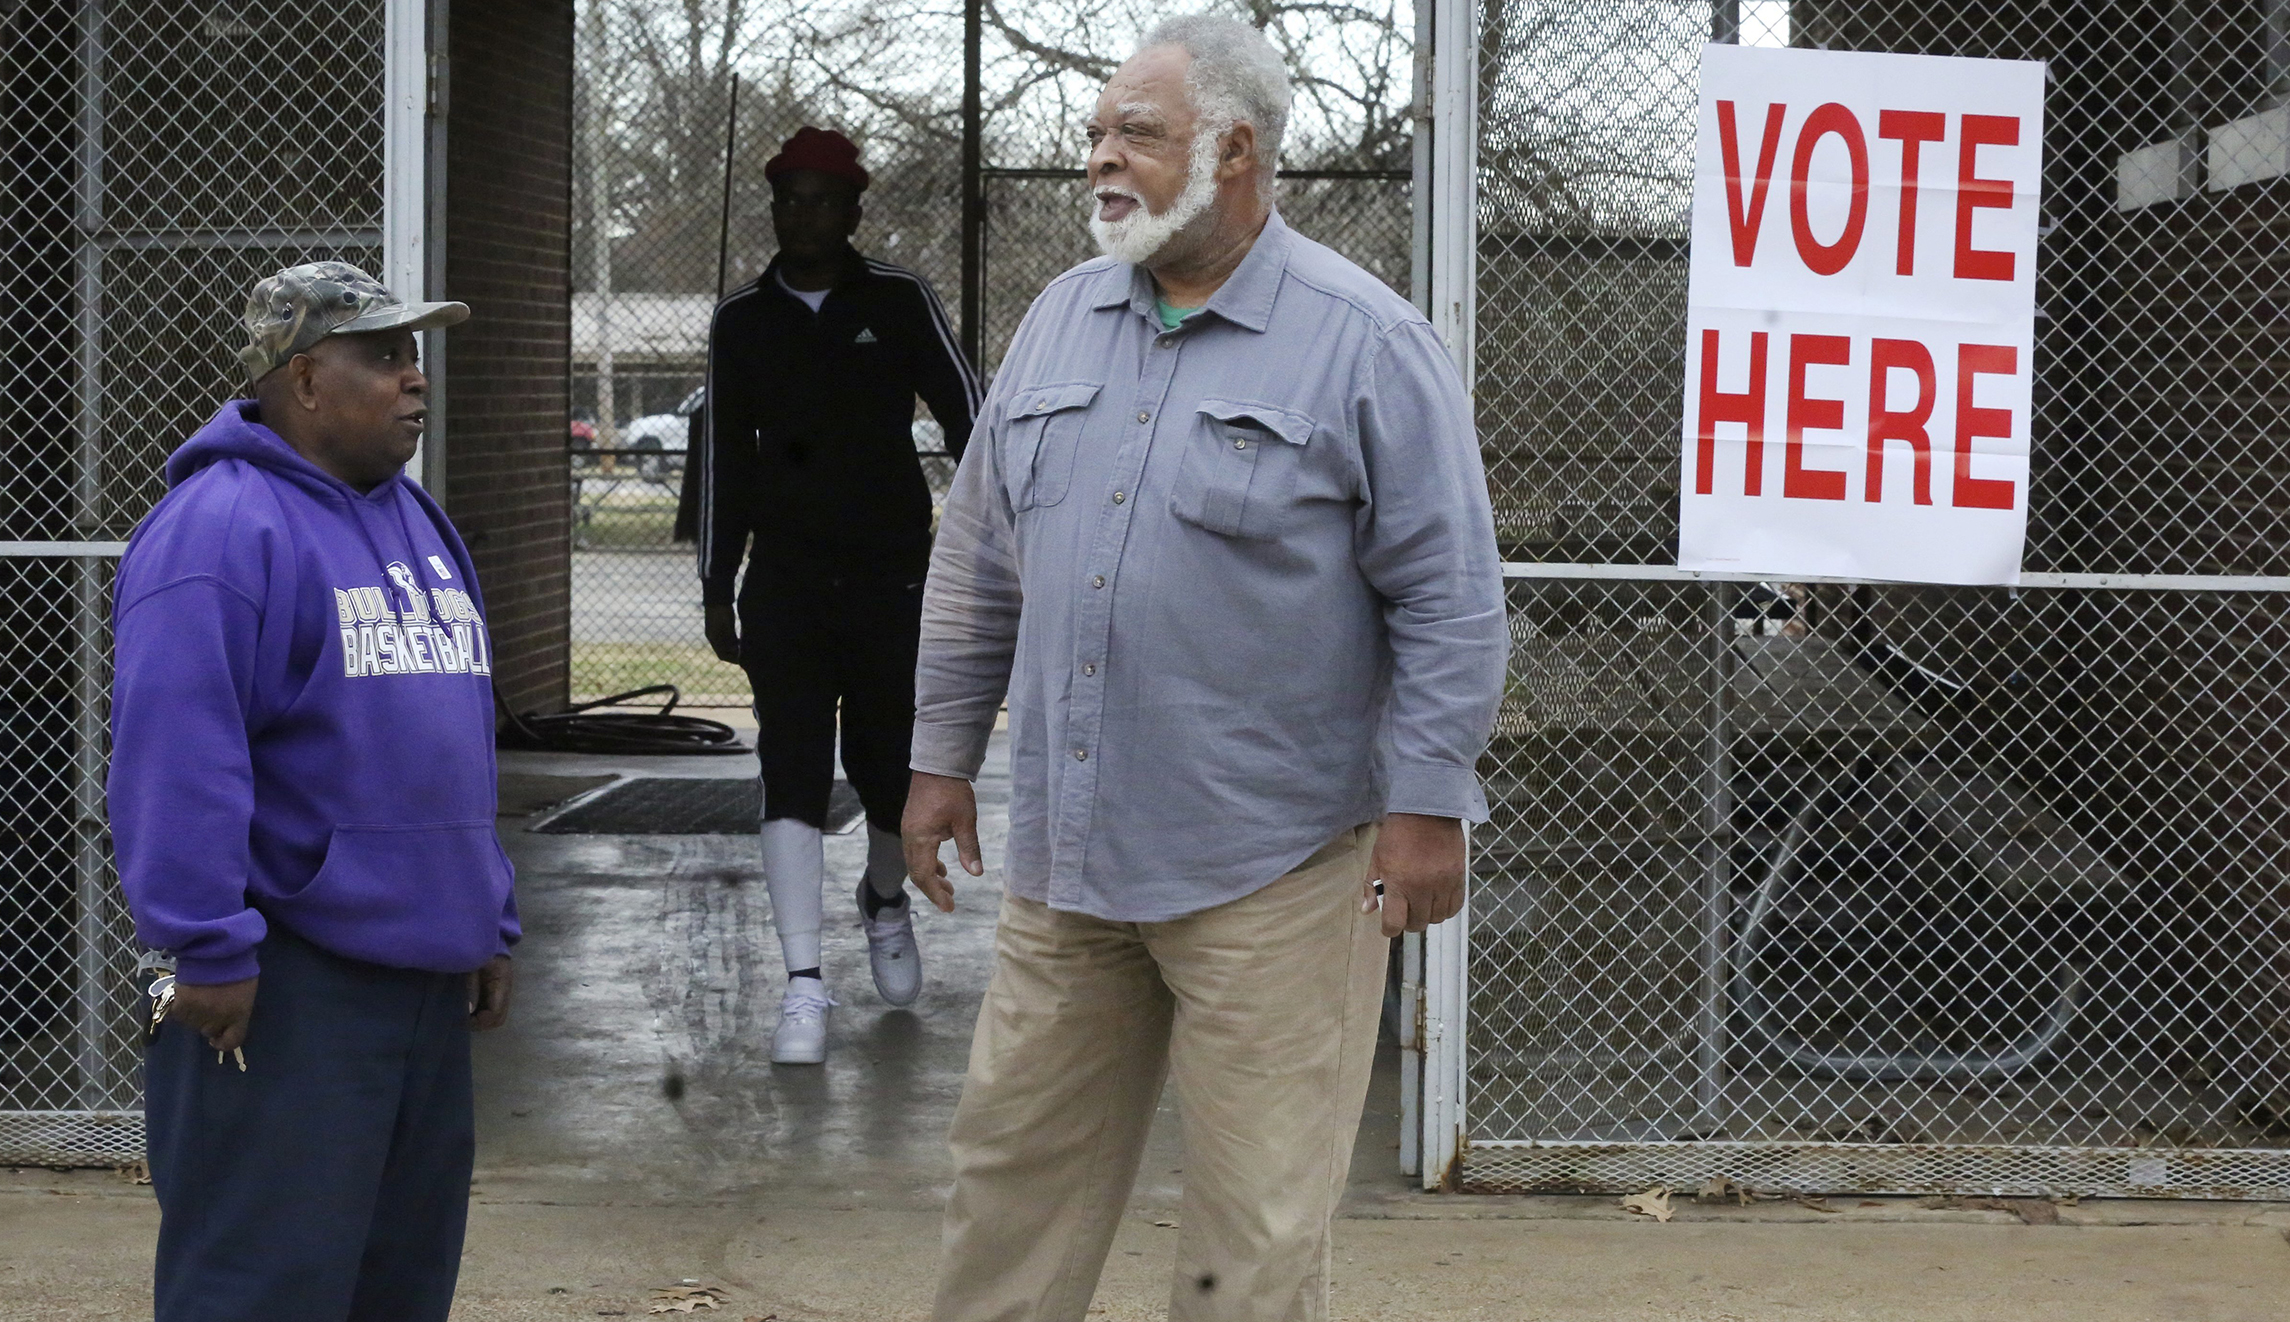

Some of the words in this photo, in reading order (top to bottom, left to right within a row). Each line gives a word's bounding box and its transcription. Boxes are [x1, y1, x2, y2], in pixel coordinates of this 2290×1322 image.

[1716, 99, 2021, 282] VOTE
[1695, 329, 2018, 510] HERE
[339, 622, 492, 678] BASKETBALL
